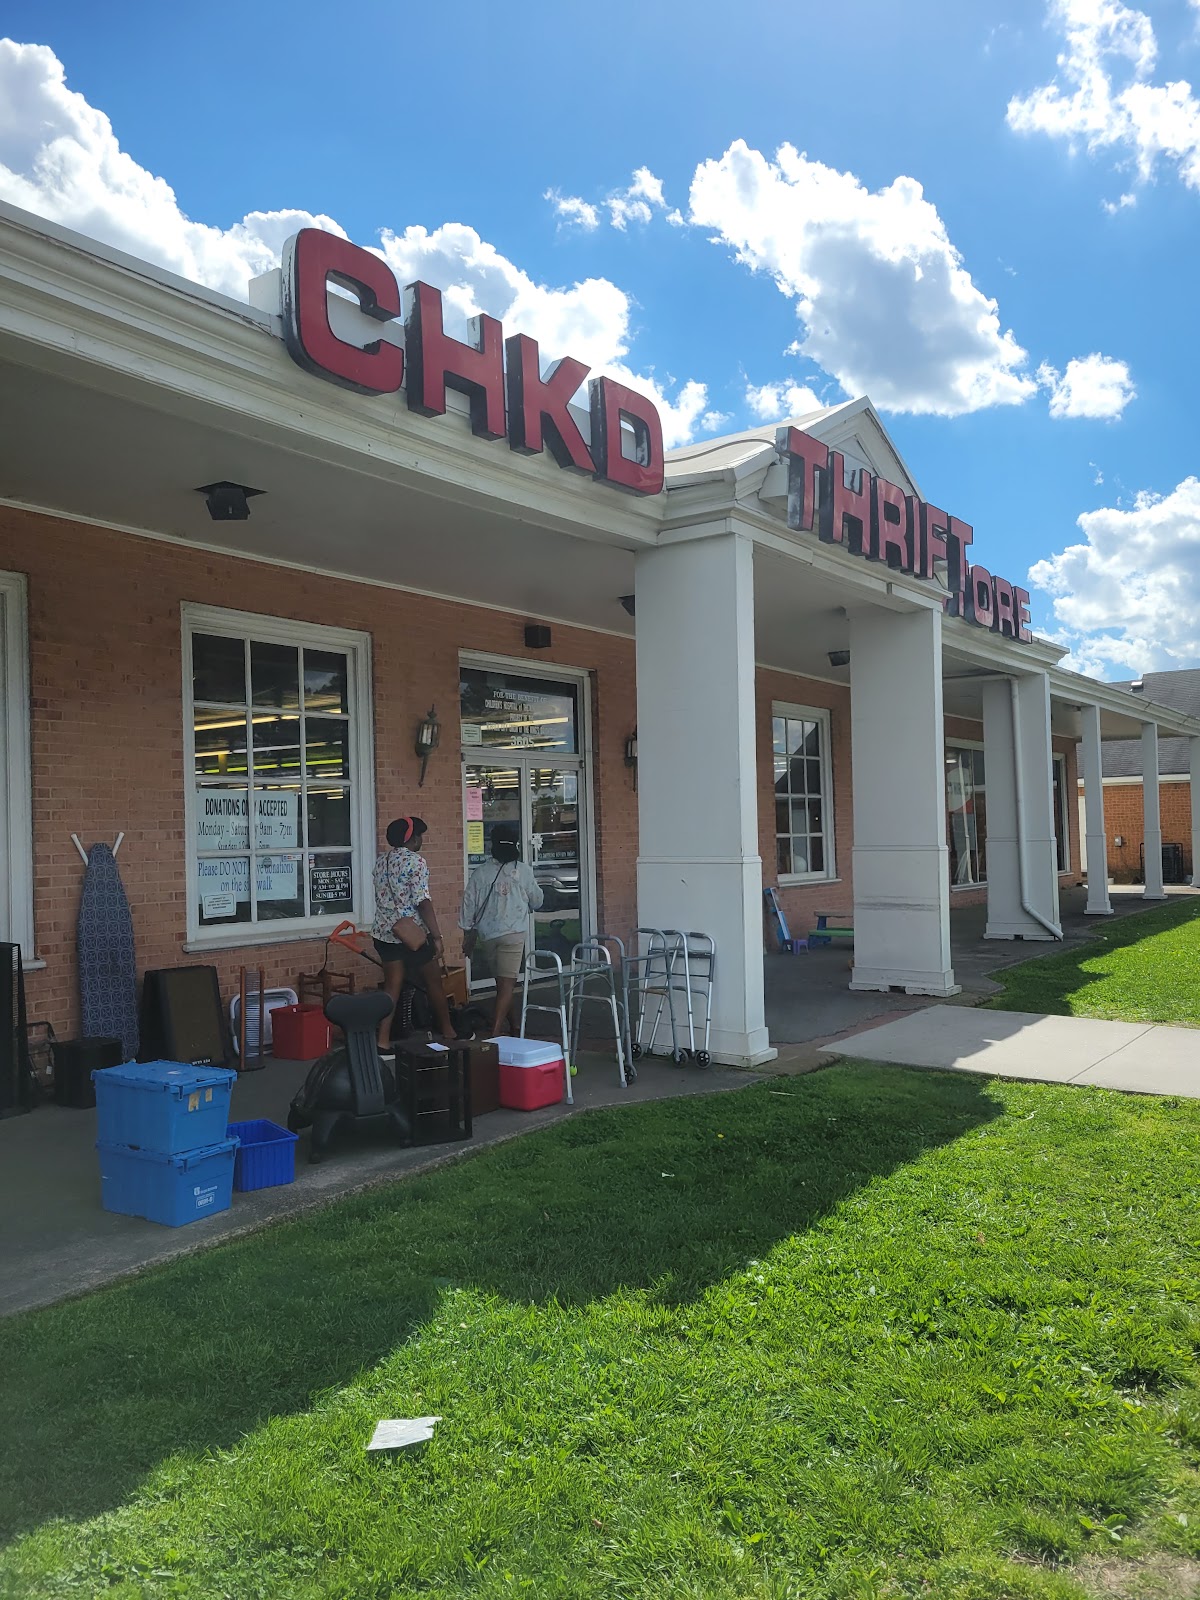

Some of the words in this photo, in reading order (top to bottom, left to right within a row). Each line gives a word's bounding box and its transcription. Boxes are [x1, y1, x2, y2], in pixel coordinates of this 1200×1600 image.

[283, 228, 664, 496] CHKD
[776, 426, 973, 592] THRIFT
[205, 798, 240, 816] DONATIONS
[259, 799, 288, 817] ACCEPTED
[198, 821, 224, 839] Monday
[259, 822, 273, 836] 9am
[198, 861, 218, 876] Please
[219, 862, 230, 876] DO
[232, 861, 247, 875] NOT
[313, 871, 330, 879] STORE
[330, 870, 348, 878] HOURS
[220, 881, 230, 891] on
[231, 877, 242, 891] the
